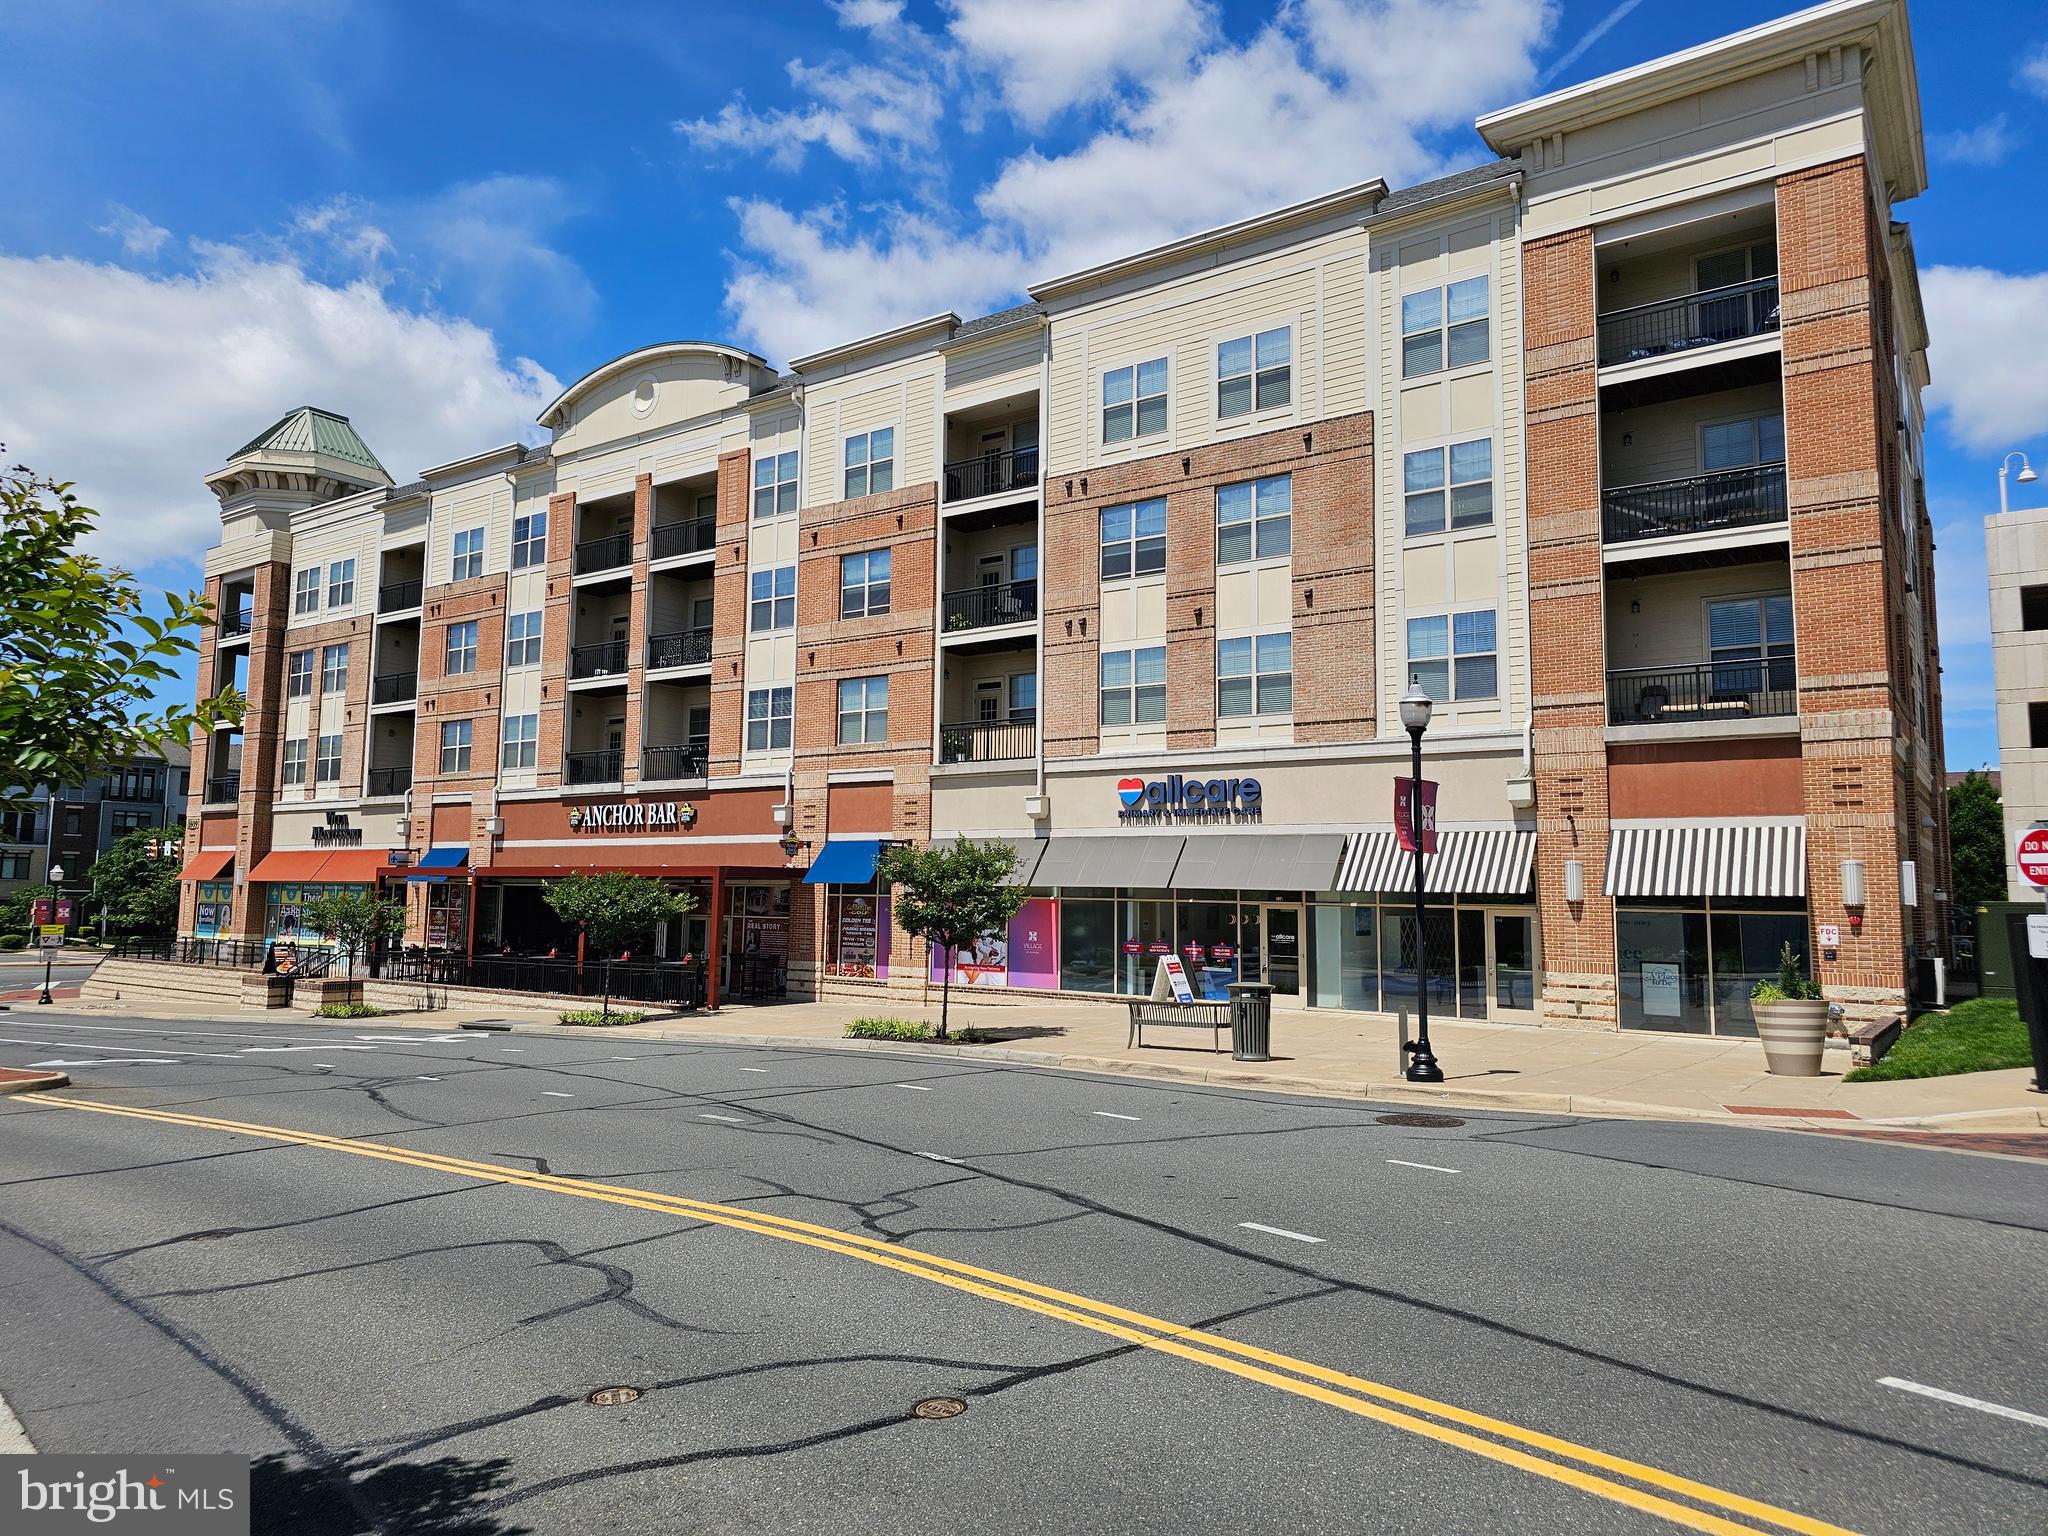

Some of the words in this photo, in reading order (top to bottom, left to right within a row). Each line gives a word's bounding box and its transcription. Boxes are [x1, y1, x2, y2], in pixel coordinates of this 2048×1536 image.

[1145, 775, 1261, 805] allcare
[582, 804, 645, 826] ANCHOR
[647, 802, 676, 825] BAR
[1118, 809, 1160, 818] PRIMARY
[1163, 808, 1173, 817] &
[1173, 807, 1230, 817] IMMEDIATE
[1231, 806, 1261, 816] CARE
[2025, 841, 2039, 850] DO
[200, 905, 215, 916] Now
[1656, 972, 1679, 980] Place
